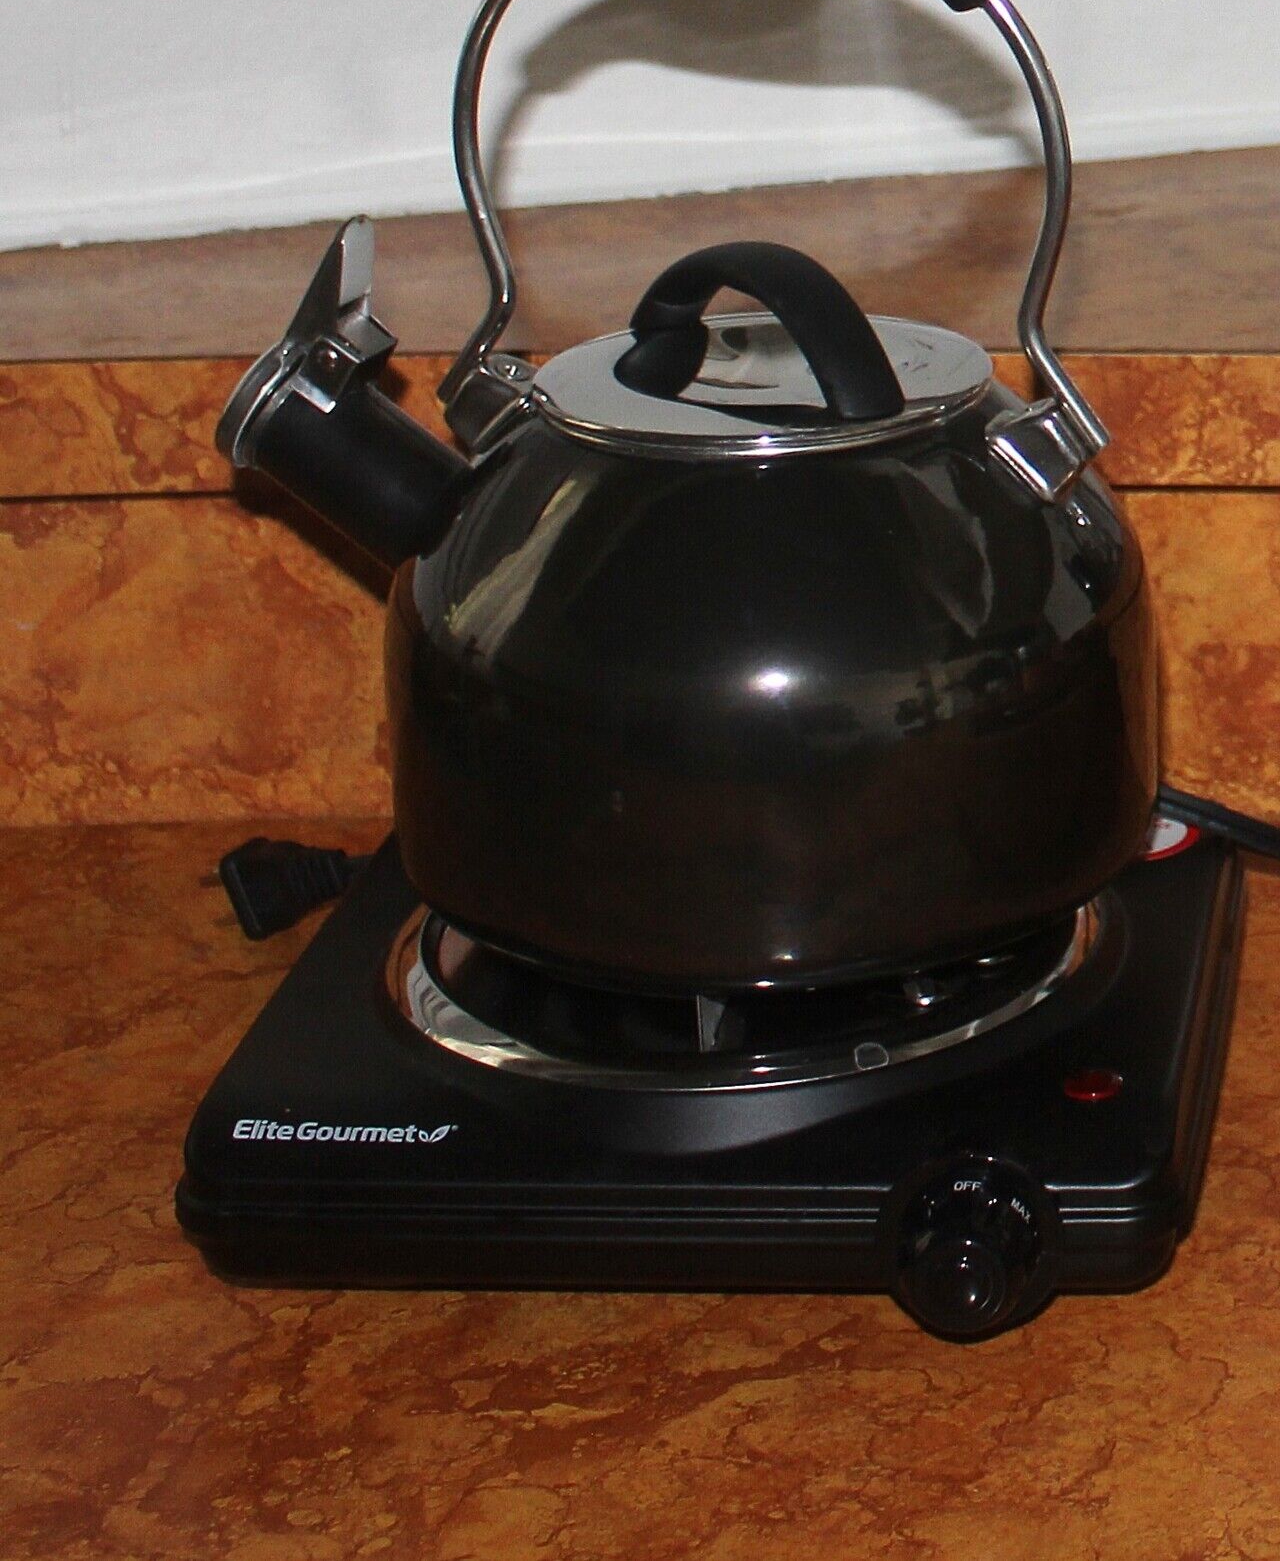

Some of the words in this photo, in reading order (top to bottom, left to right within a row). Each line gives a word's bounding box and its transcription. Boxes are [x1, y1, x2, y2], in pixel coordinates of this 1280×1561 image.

[232, 1119, 294, 1139] Elite
[297, 1122, 418, 1143] Gourmet
[954, 1181, 982, 1191] OFF
[1010, 1197, 1031, 1223] MAX
